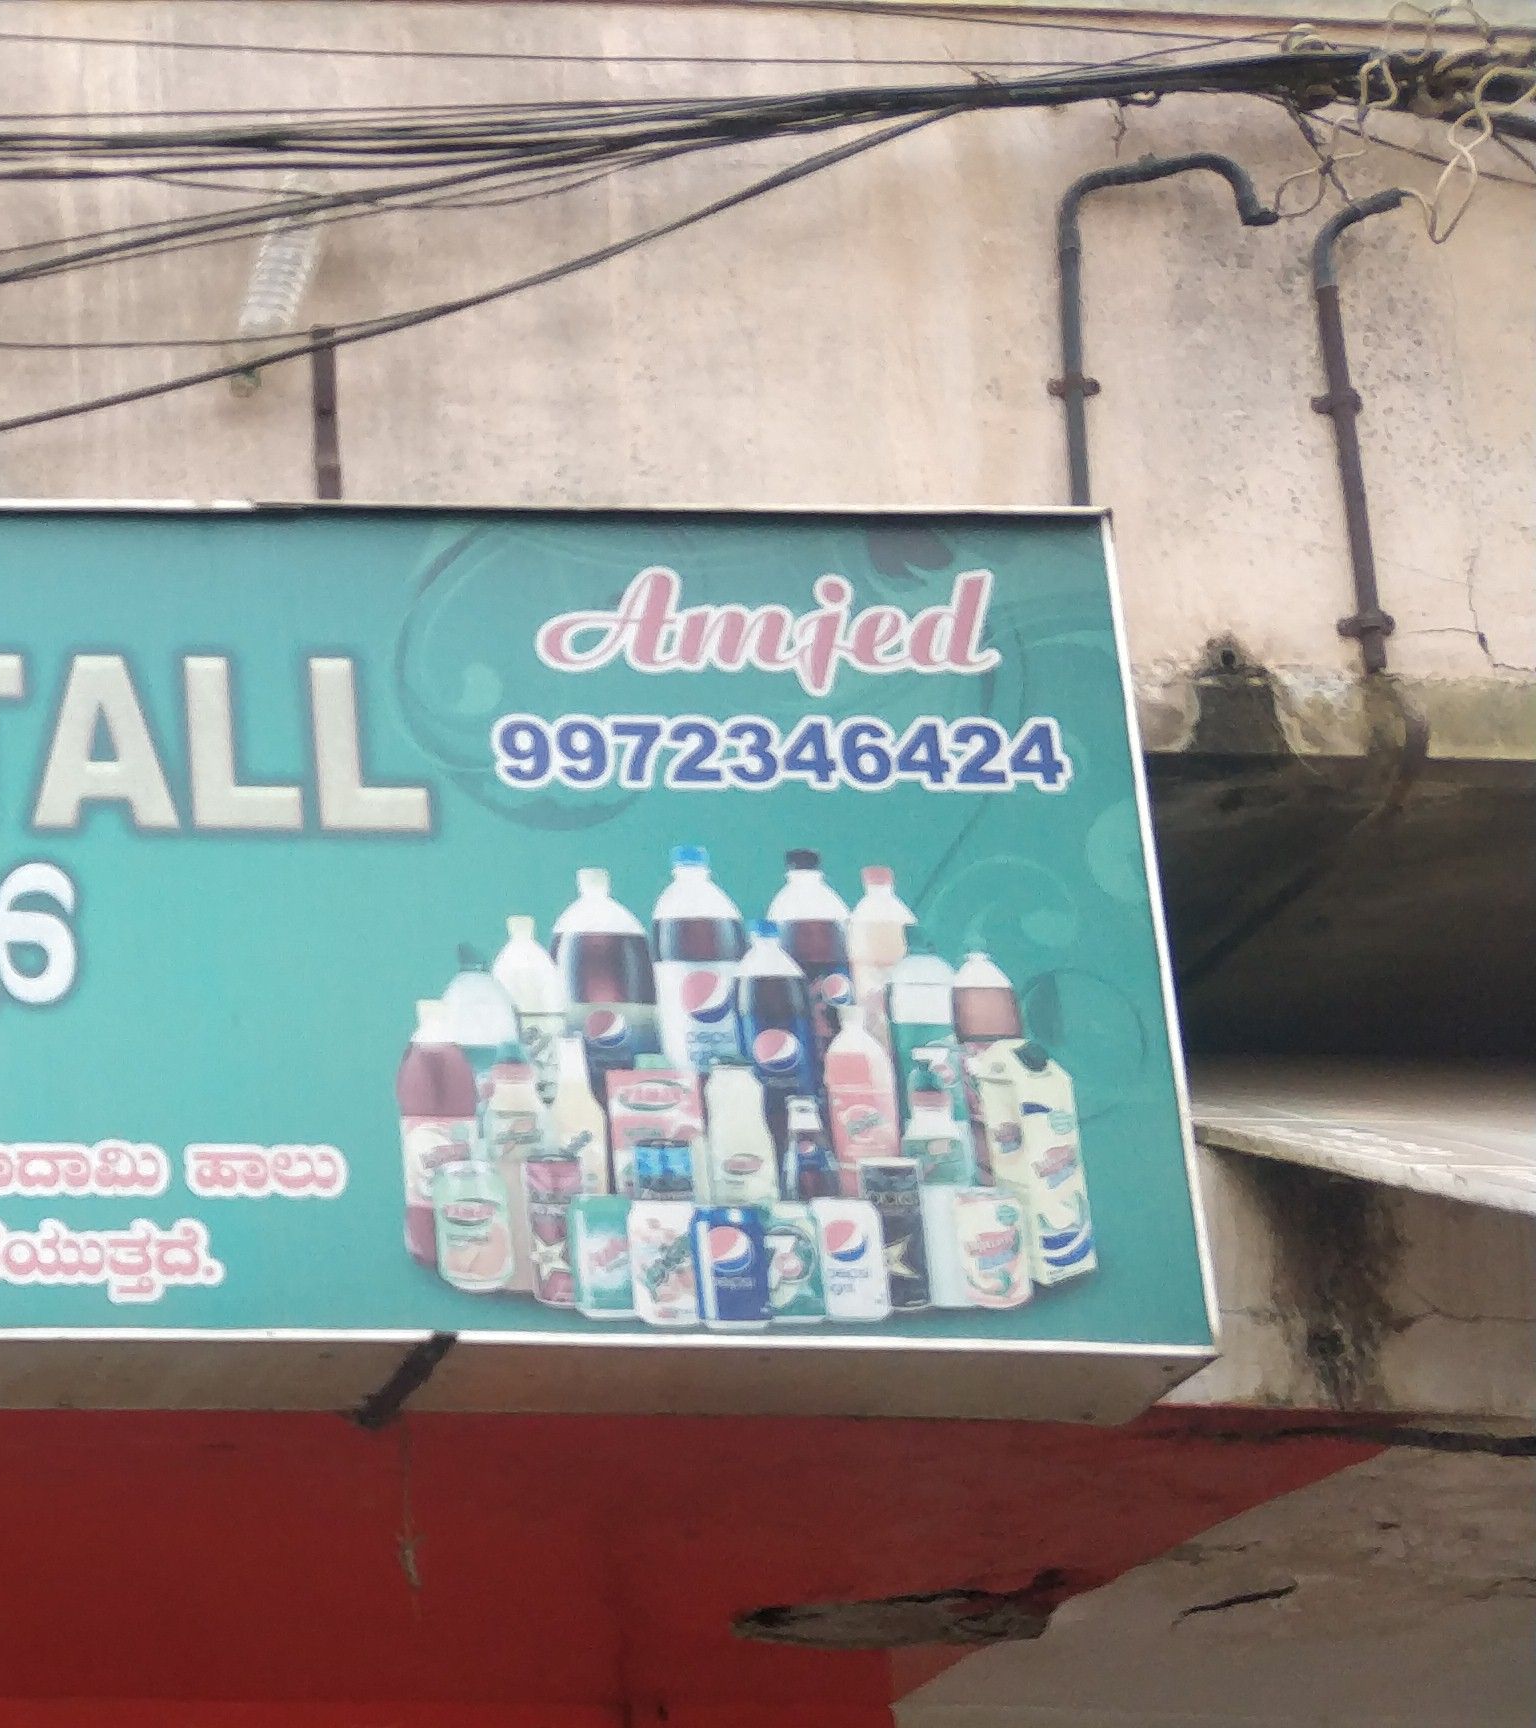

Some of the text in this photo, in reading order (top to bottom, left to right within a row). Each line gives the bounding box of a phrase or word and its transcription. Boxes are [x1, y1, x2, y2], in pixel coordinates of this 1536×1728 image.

[537, 566, 1002, 697] Amjed
[492, 711, 1073, 794] 9972346424
[184, 1142, 348, 1199] ಹಾಲು
